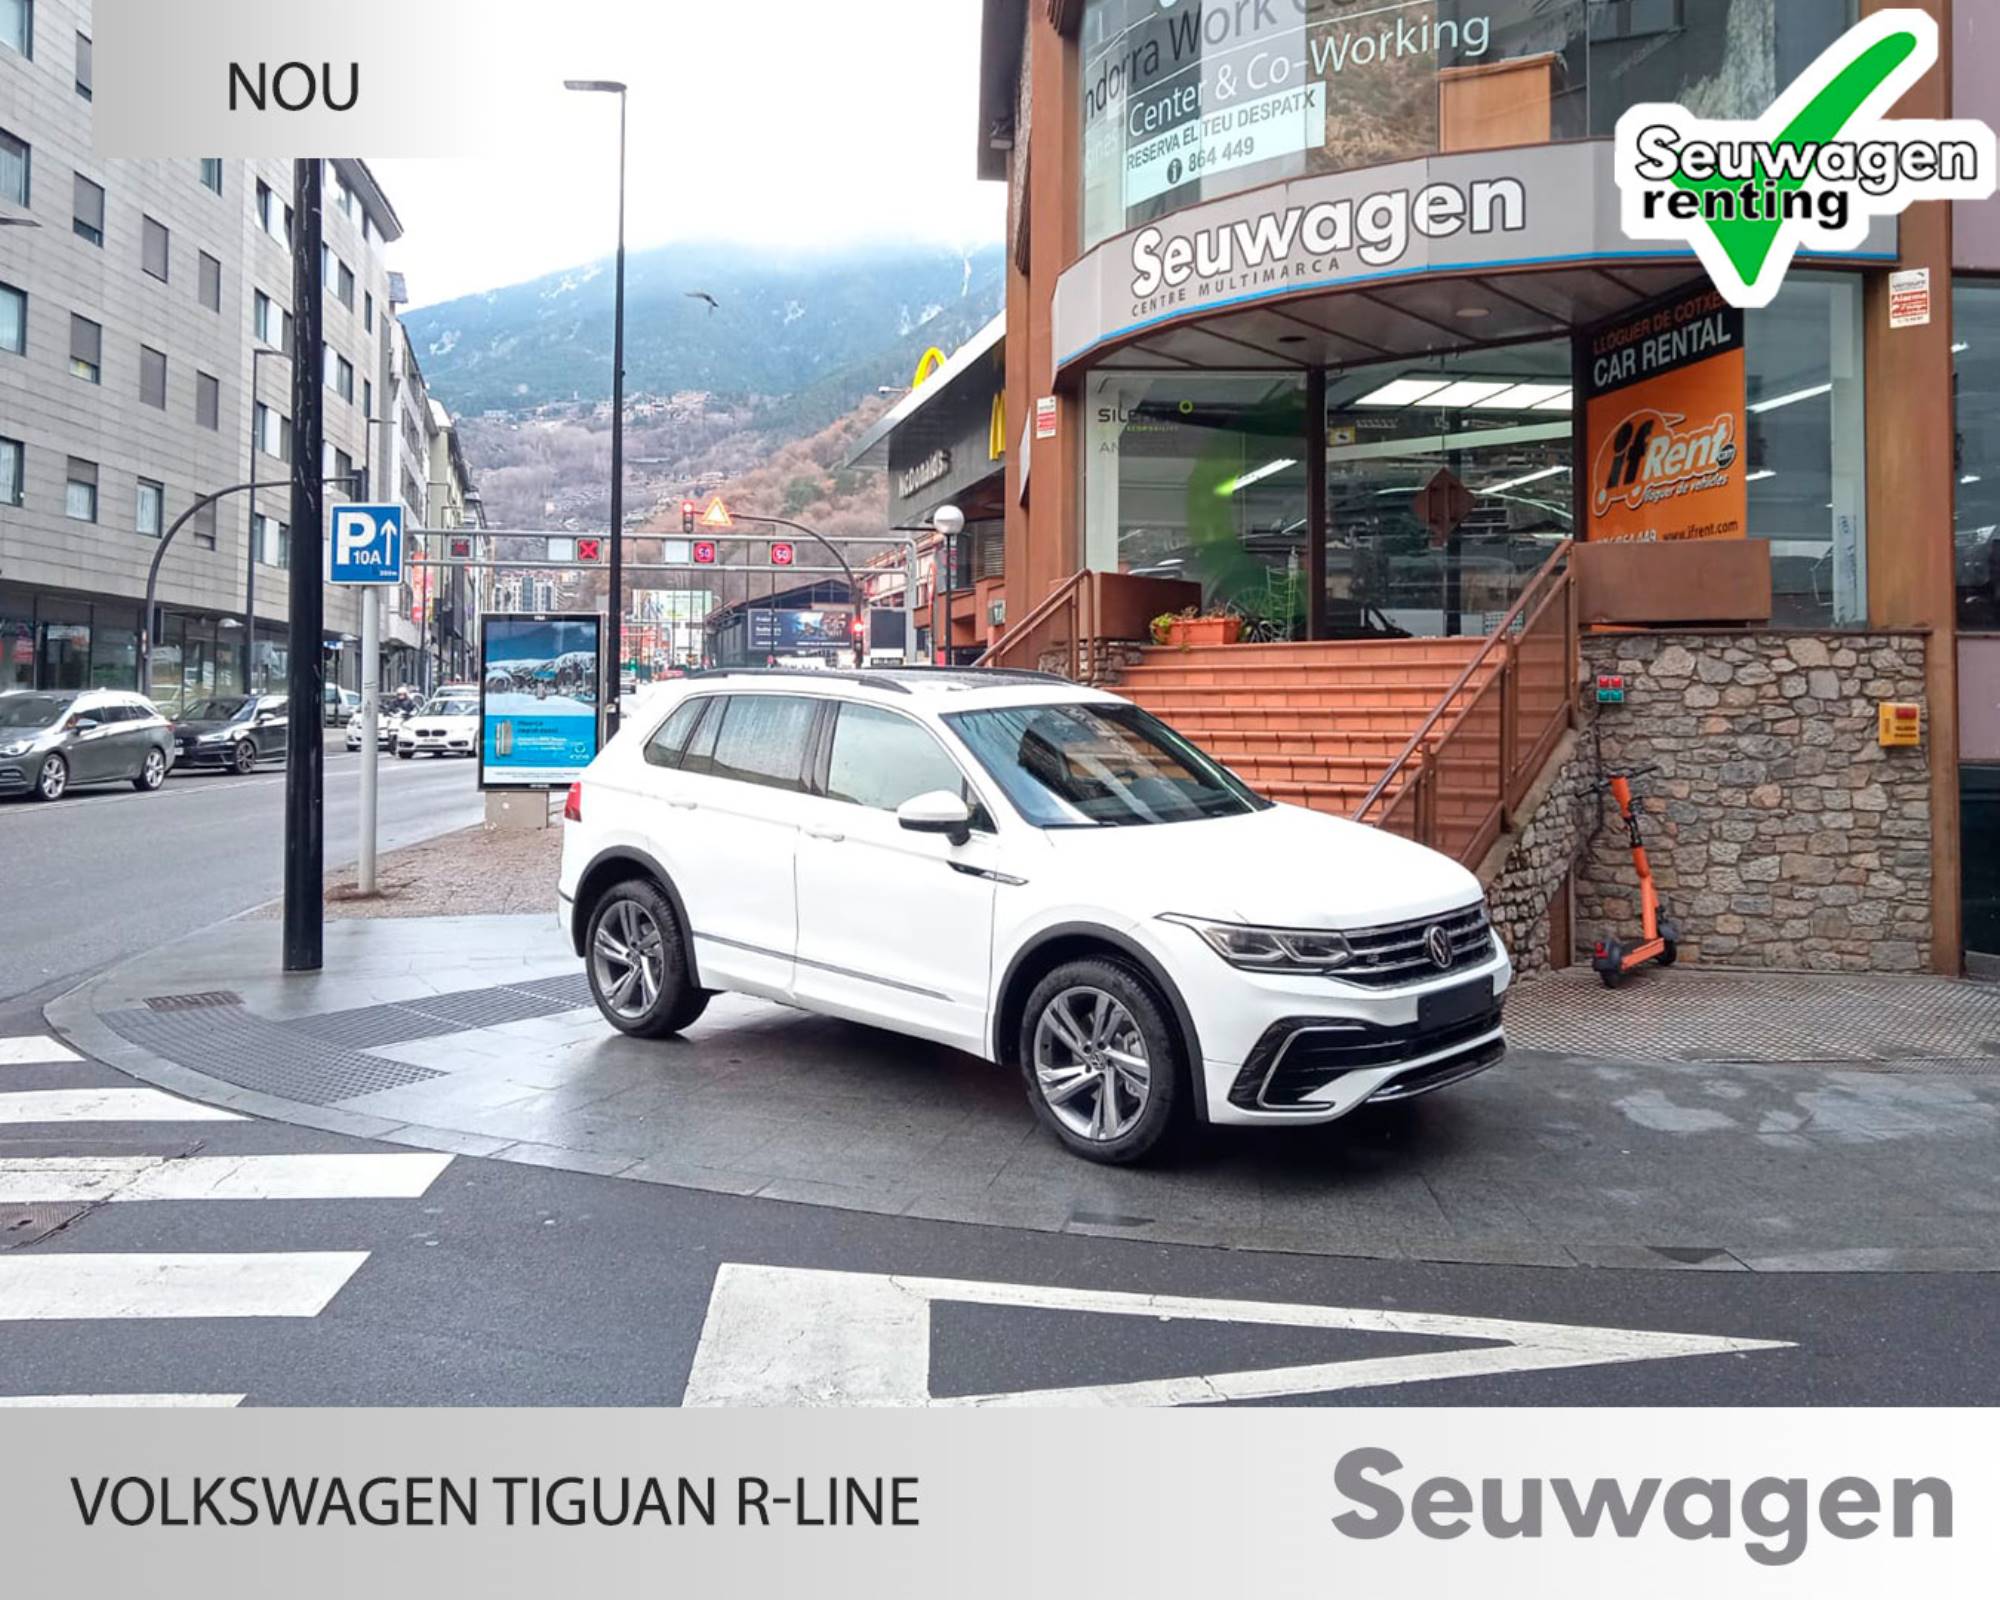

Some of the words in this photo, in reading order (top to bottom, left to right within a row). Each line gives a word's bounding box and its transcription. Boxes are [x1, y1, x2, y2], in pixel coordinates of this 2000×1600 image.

[1168, 0, 1278, 62] Work
[1128, 79, 1208, 137] Center
[1214, 63, 1238, 100] &
[1246, 14, 1490, 90] Co-Working
[1126, 134, 1181, 171] RESERVA
[1182, 124, 1200, 147] EL
[1202, 115, 1233, 138] TEU
[1237, 89, 1316, 126] DESPATX
[1188, 147, 1217, 172] 864
[1222, 135, 1255, 161] 449
[1131, 175, 1526, 299] Seuwagen
[1130, 288, 1187, 318] CENTRE
[1198, 257, 1341, 297] MULTIMARCA
[1673, 289, 1728, 323] COTXE
[1593, 346, 1637, 388] CAR
[1641, 312, 1732, 371] RENTAL
[336, 511, 377, 566] P
[352, 549, 382, 566] 10A
